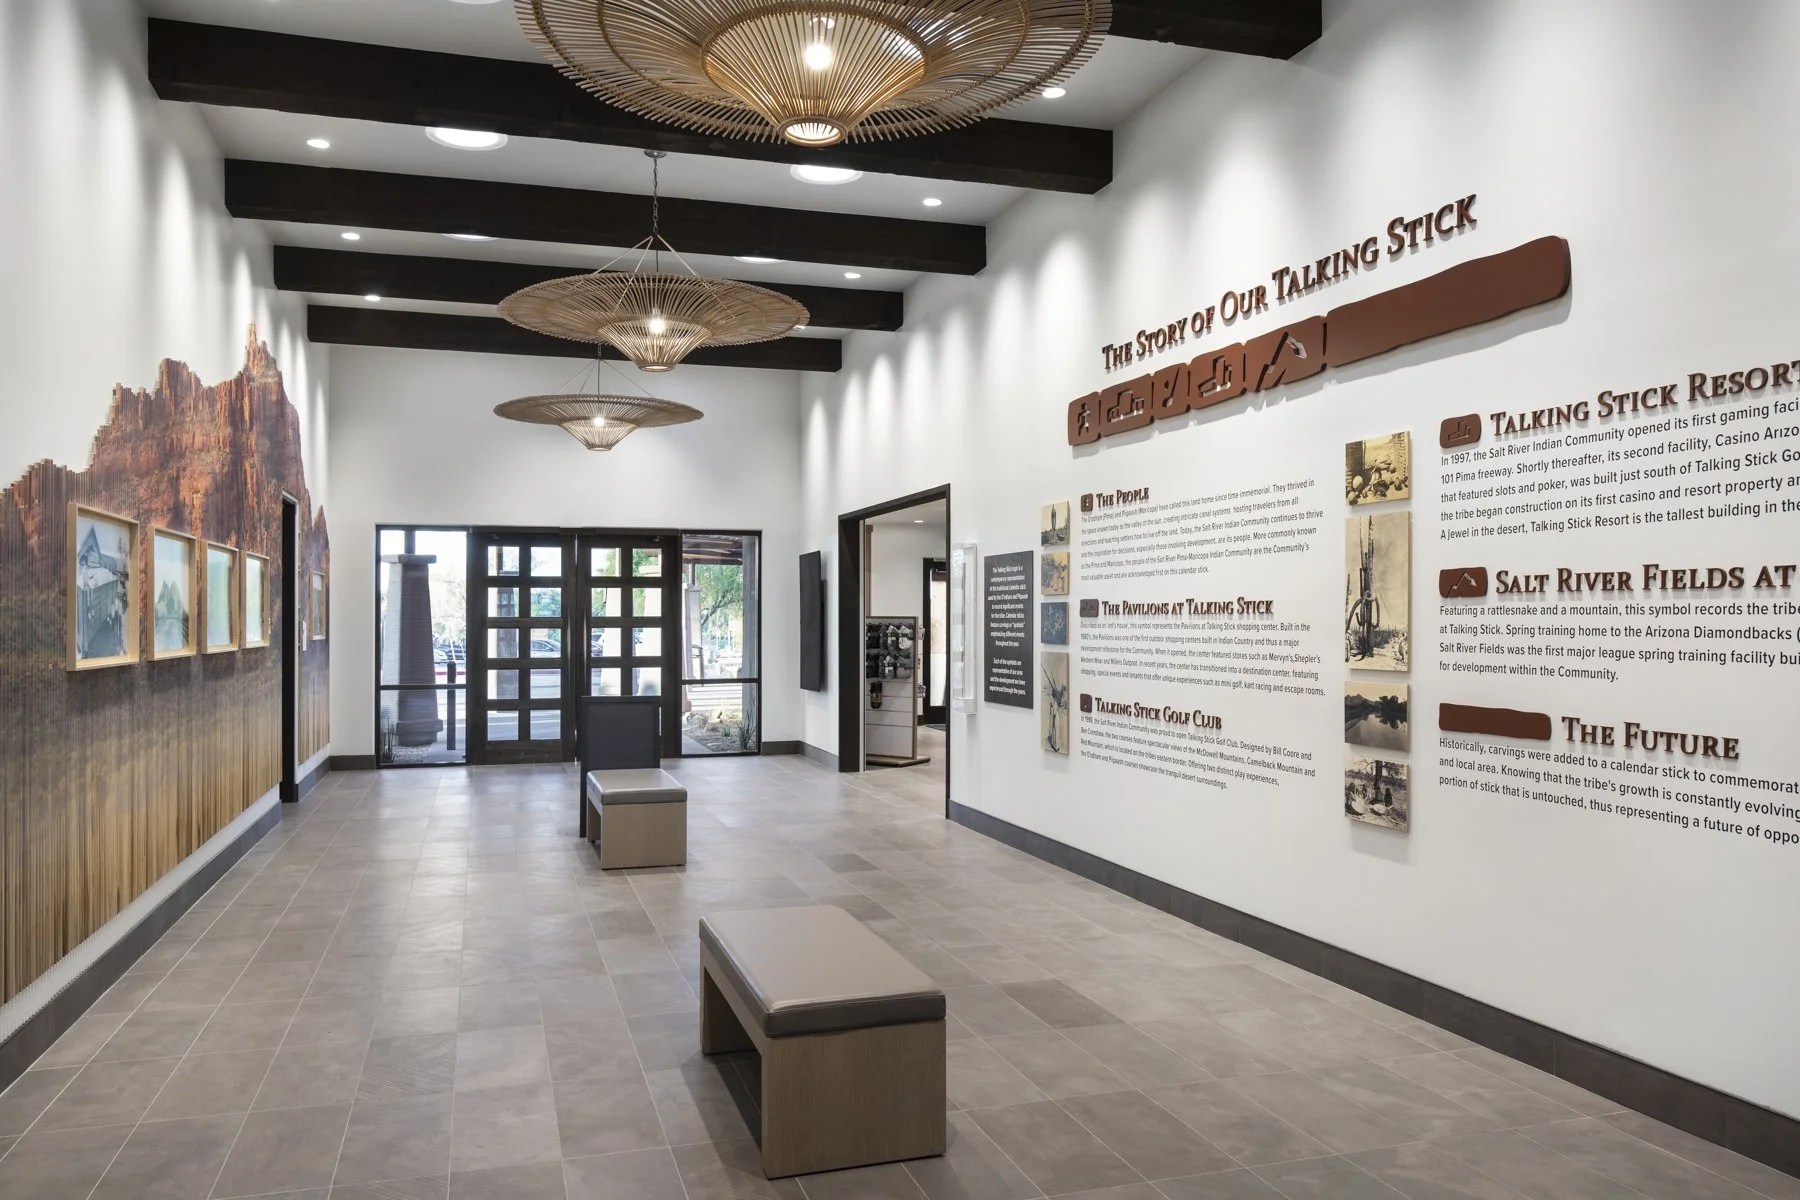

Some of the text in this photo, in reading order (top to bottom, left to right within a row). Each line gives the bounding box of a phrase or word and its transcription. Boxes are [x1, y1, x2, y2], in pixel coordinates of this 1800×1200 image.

[1441, 456, 1449, 466] In
[1450, 452, 1472, 464] 1997,
[1473, 451, 1487, 461] the
[1489, 447, 1505, 459] Salt
[1507, 444, 1531, 456] River
[1533, 438, 1562, 451] Indian
[1565, 428, 1625, 447] Community
[1627, 419, 1671, 439] opened
[1674, 417, 1689, 430] its
[1692, 412, 1716, 427] first
[1720, 405, 1769, 426] gaming
[1441, 473, 1454, 484] 101
[1455, 471, 1476, 482] Pima
[1477, 467, 1514, 479] freeway.
[1516, 460, 1549, 474] Shortly
[1551, 453, 1605, 469] thereafter,
[1608, 450, 1621, 461] its
[1624, 442, 1664, 460] second
[1667, 437, 1711, 453] facility,
[1715, 431, 1760, 447] Casino
[1215, 494, 1227, 502] since
[1227, 491, 1239, 500] time
[1272, 484, 1286, 494] They
[1287, 479, 1308, 491] thrived
[1308, 478, 1315, 487] in
[1224, 509, 1324, 529] Indian Community continues to thrive
[1440, 529, 1446, 539] A
[1471, 526, 1479, 537] in
[1481, 525, 1495, 536] the
[1496, 523, 1528, 535] desert,
[1530, 519, 1565, 533] Talking
[1567, 516, 1592, 529] Stick
[1595, 514, 1629, 527] Resort
[1632, 512, 1642, 524] is
[1644, 511, 1663, 523] the
[1666, 507, 1704, 522] tallest
[1708, 502, 1760, 518] building
[1765, 500, 1777, 514] in
[1263, 546, 1272, 554] the
[1273, 542, 1310, 554] Community's
[1440, 605, 1478, 618] Featuring
[1480, 607, 1485, 615] a
[1487, 605, 1538, 616] rattlesnake
[1540, 604, 1558, 615] and
[1560, 606, 1567, 615] a
[1569, 603, 1622, 616] mountain,
[1625, 603, 1646, 615] this
[1648, 603, 1691, 618] symbol
[1695, 602, 1743, 615] records
[1746, 602, 1769, 615] the
[1206, 622, 1224, 632] Talking
[1224, 622, 1236, 631] Stick
[1236, 622, 1260, 633] shopping
[1280, 622, 1293, 631] Built
[1294, 622, 1300, 631] in
[1300, 623, 1311, 632] the
[1439, 623, 1792, 640] at Talking Stick. Spring training home to the Arizona Diamondbacks
[1268, 652, 1321, 665] Mervyn's,Shepler's
[1439, 660, 1619, 683] for development within the Community.
[1220, 679, 1232, 687] mini
[1244, 681, 1255, 690] kart
[1255, 682, 1272, 693] racing
[1272, 684, 1284, 692] and
[1284, 686, 1304, 695] escape
[1240, 740, 1312, 761] Designed by Bill Coore and
[1439, 737, 1486, 755] Historically,
[1488, 745, 1526, 760] carvings
[1527, 751, 1551, 762] were
[1553, 753, 1585, 766] added
[1587, 756, 1598, 768] to
[1601, 760, 1607, 769] a
[1610, 760, 1659, 776] calendar
[1662, 766, 1690, 780] stick
[1693, 769, 1706, 782] to
[1216, 765, 1234, 776] distinct
[1235, 769, 1246, 780] play
[1246, 756, 1315, 777] Camelback Mountain and
[1439, 776, 1468, 788] portion
[1469, 779, 1479, 790] of
[1480, 781, 1500, 794] stick
[1502, 784, 1520, 797] that
[1522, 787, 1530, 799] is
[1532, 791, 1587, 810] untouched,
[1589, 799, 1612, 813] thus
[1615, 805, 1689, 829] representing
[1692, 818, 1700, 828] a
[1703, 816, 1743, 835] future
[1746, 824, 1760, 837] of
